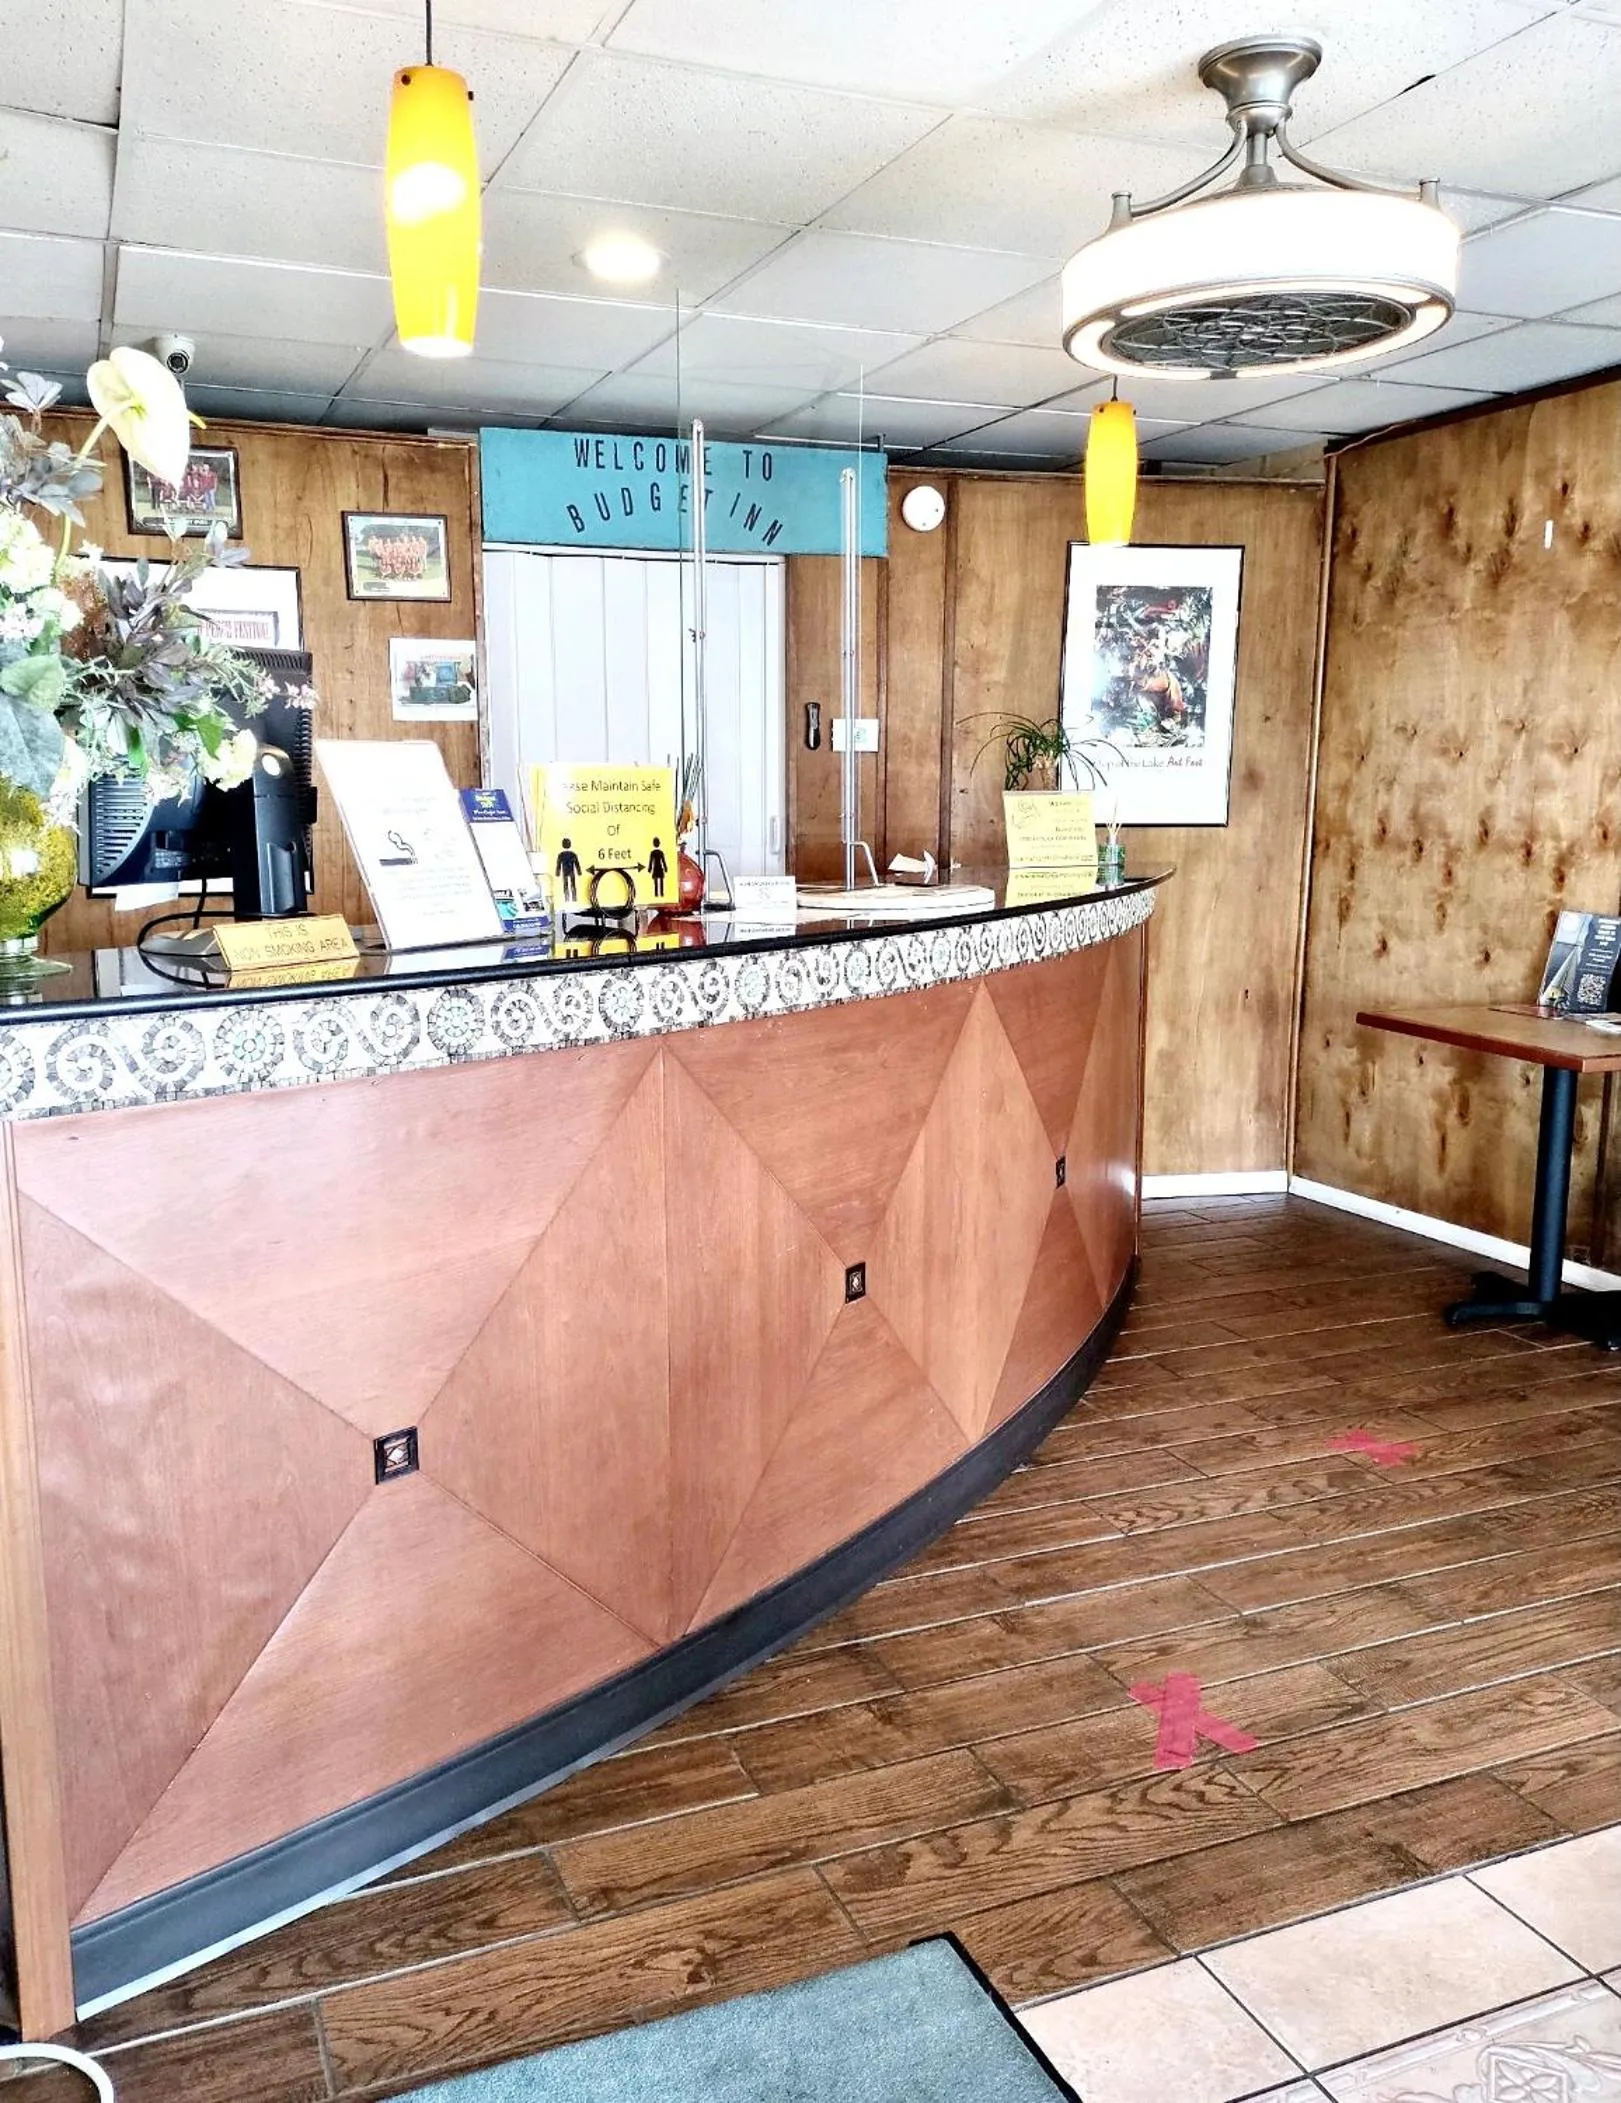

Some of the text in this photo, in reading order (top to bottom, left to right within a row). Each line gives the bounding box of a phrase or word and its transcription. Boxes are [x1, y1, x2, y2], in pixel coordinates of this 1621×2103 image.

[574, 437, 773, 481] WELCOME TO
[567, 482, 784, 546] BUDGET INN
[234, 621, 271, 640] FESTIVAL
[590, 780, 639, 792] Maintain
[641, 779, 661, 792] Safe
[566, 801, 656, 815] Social Distancing
[607, 824, 620, 836] Of
[598, 848, 632, 860] 6 Feet
[265, 923, 308, 939] THIS IS
[264, 940, 315, 957] SMOKING
[319, 937, 348, 951] AREA
